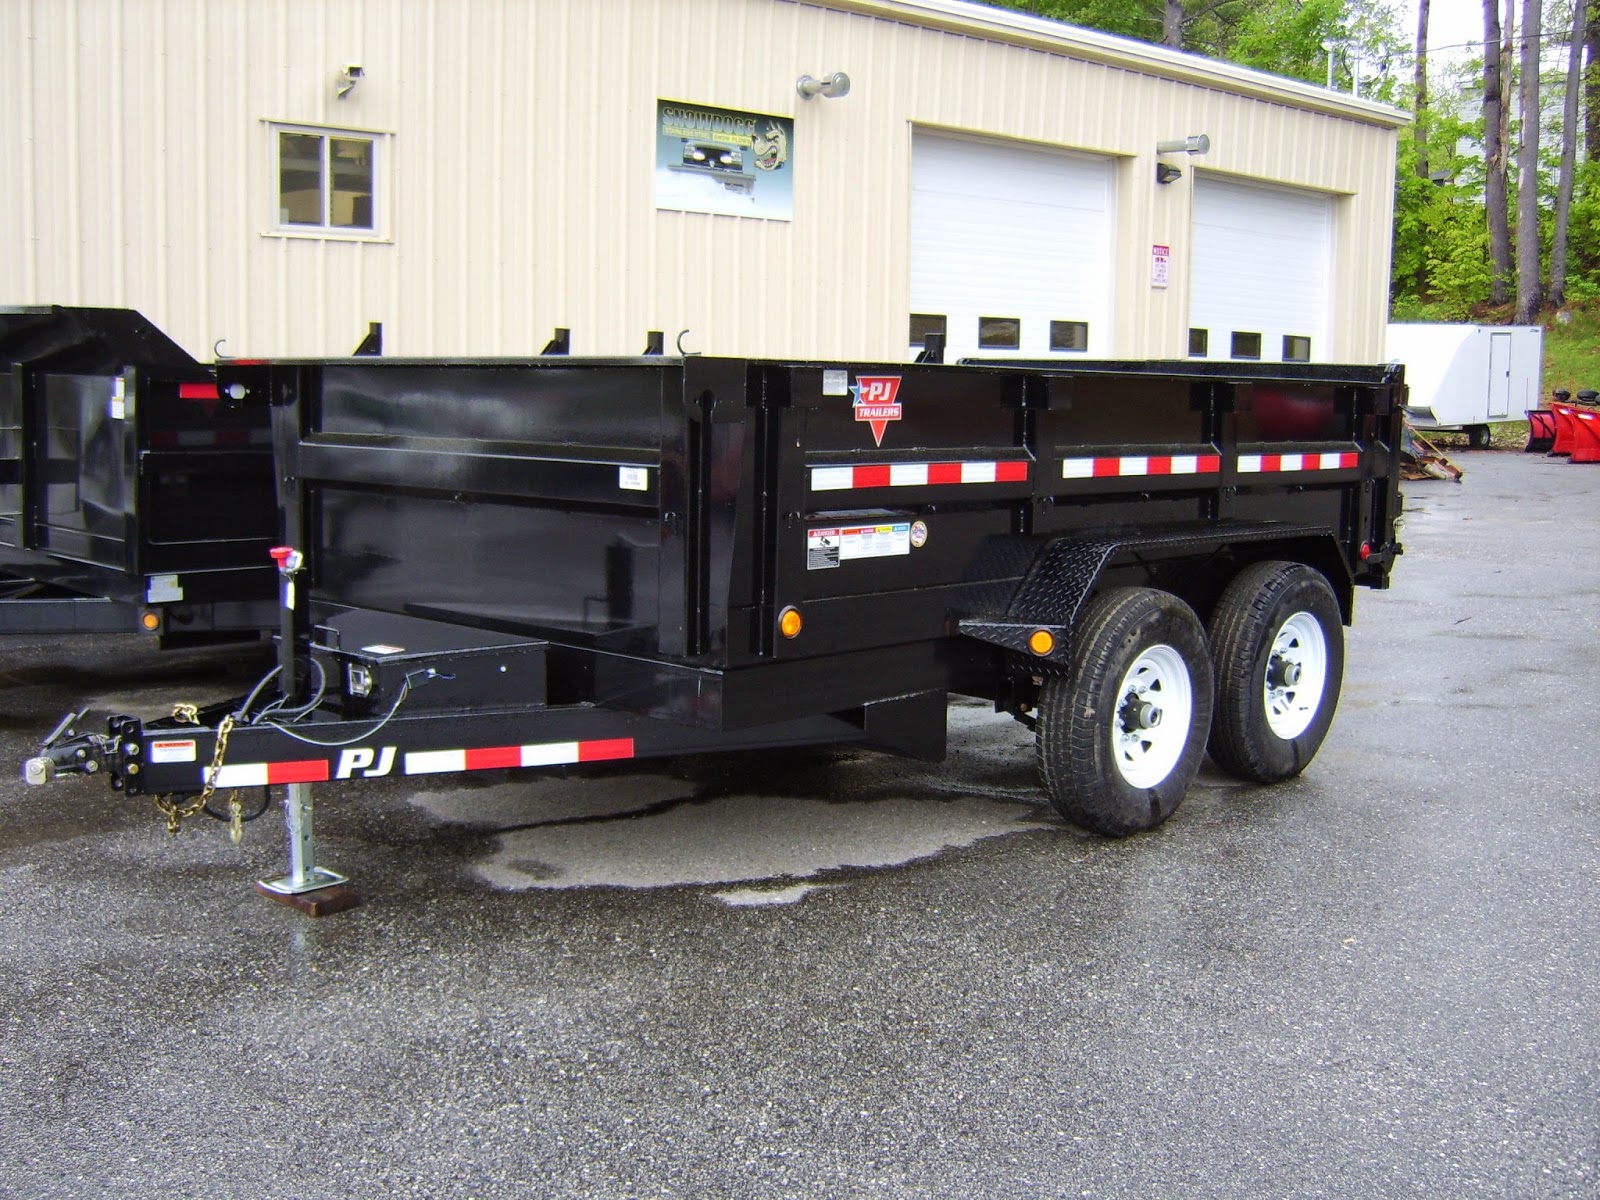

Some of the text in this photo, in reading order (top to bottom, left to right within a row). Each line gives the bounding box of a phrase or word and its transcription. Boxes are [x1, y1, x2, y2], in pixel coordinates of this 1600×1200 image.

[714, 133, 731, 142] SNOW
[868, 382, 892, 401] PJ
[858, 407, 899, 417] TRAILERS
[335, 746, 397, 779] PJ
